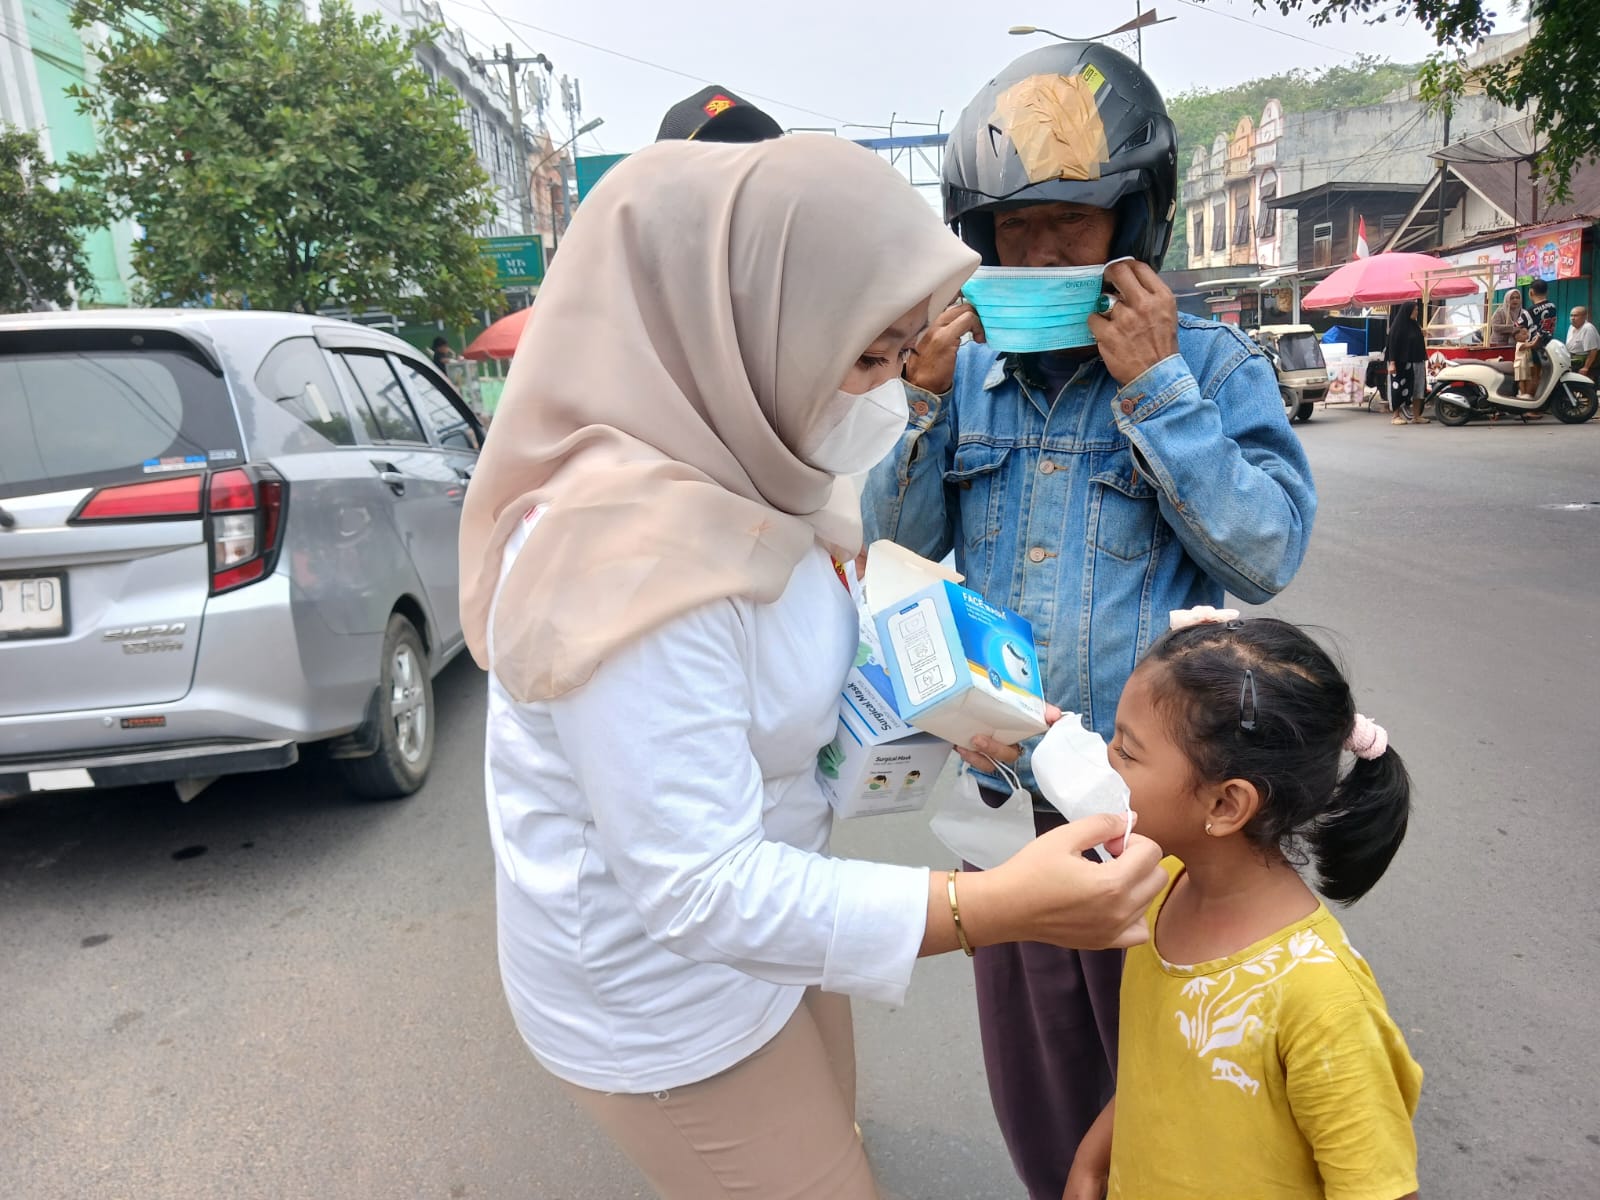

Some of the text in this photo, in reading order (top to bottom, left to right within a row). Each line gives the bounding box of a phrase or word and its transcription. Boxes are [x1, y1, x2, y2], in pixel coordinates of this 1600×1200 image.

[21, 579, 55, 613] FD
[847, 682, 868, 702] Mask
[862, 700, 892, 731] Surgical
